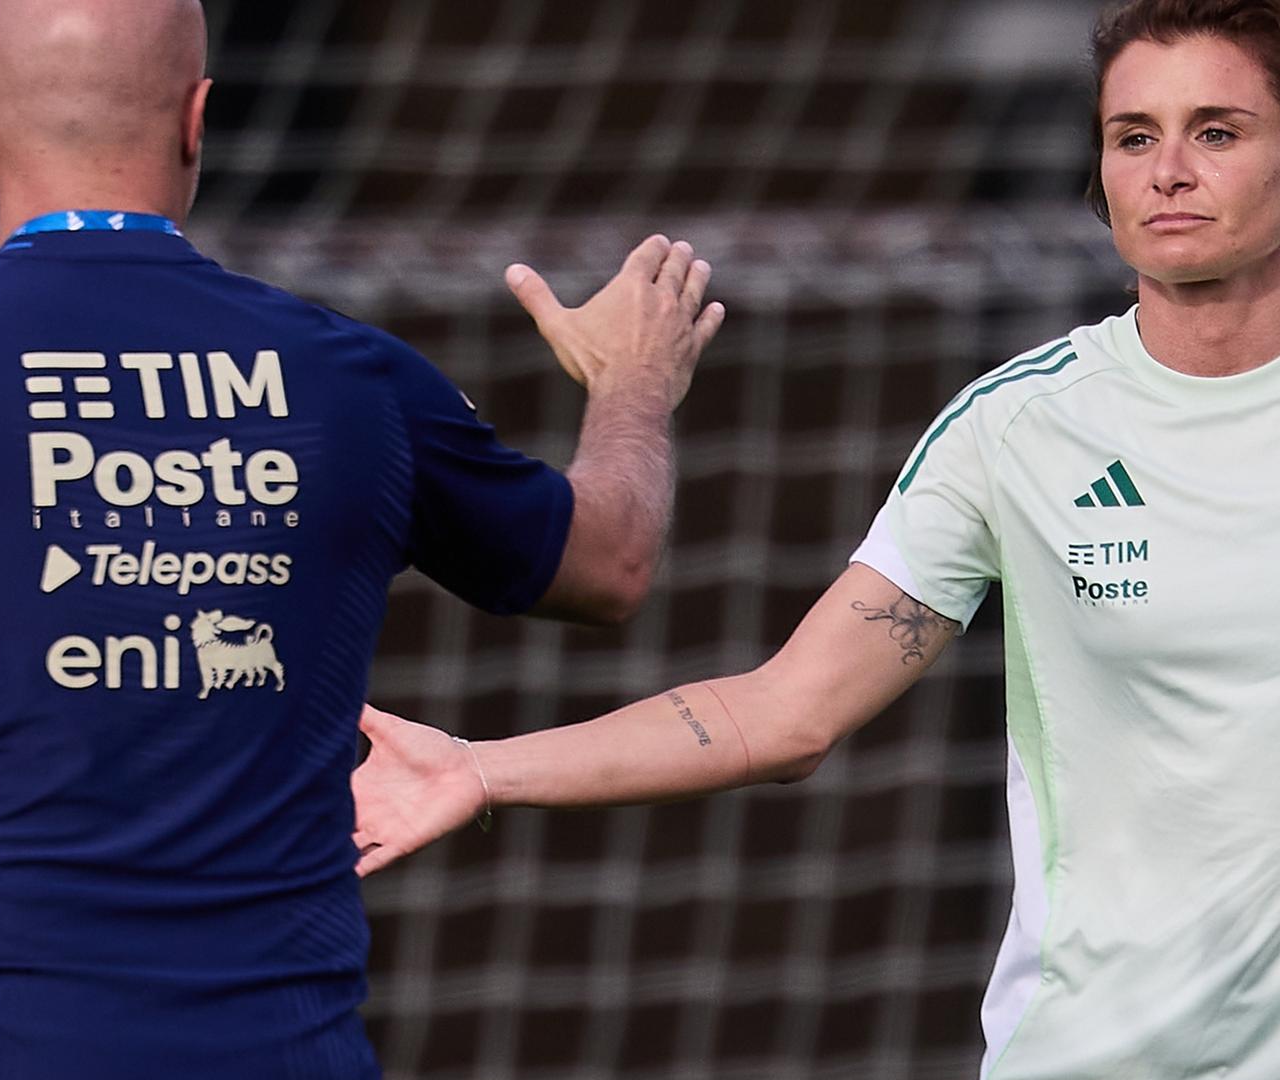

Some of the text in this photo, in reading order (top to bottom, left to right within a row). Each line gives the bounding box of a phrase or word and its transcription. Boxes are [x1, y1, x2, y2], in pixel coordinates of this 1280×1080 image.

[119, 350, 289, 419] TIM
[28, 431, 299, 507] Poste
[31, 506, 300, 530] italiane
[85, 540, 293, 595] Telepass
[1100, 539, 1148, 565] TIM
[1072, 575, 1148, 600] Poste
[45, 614, 181, 690] eni
